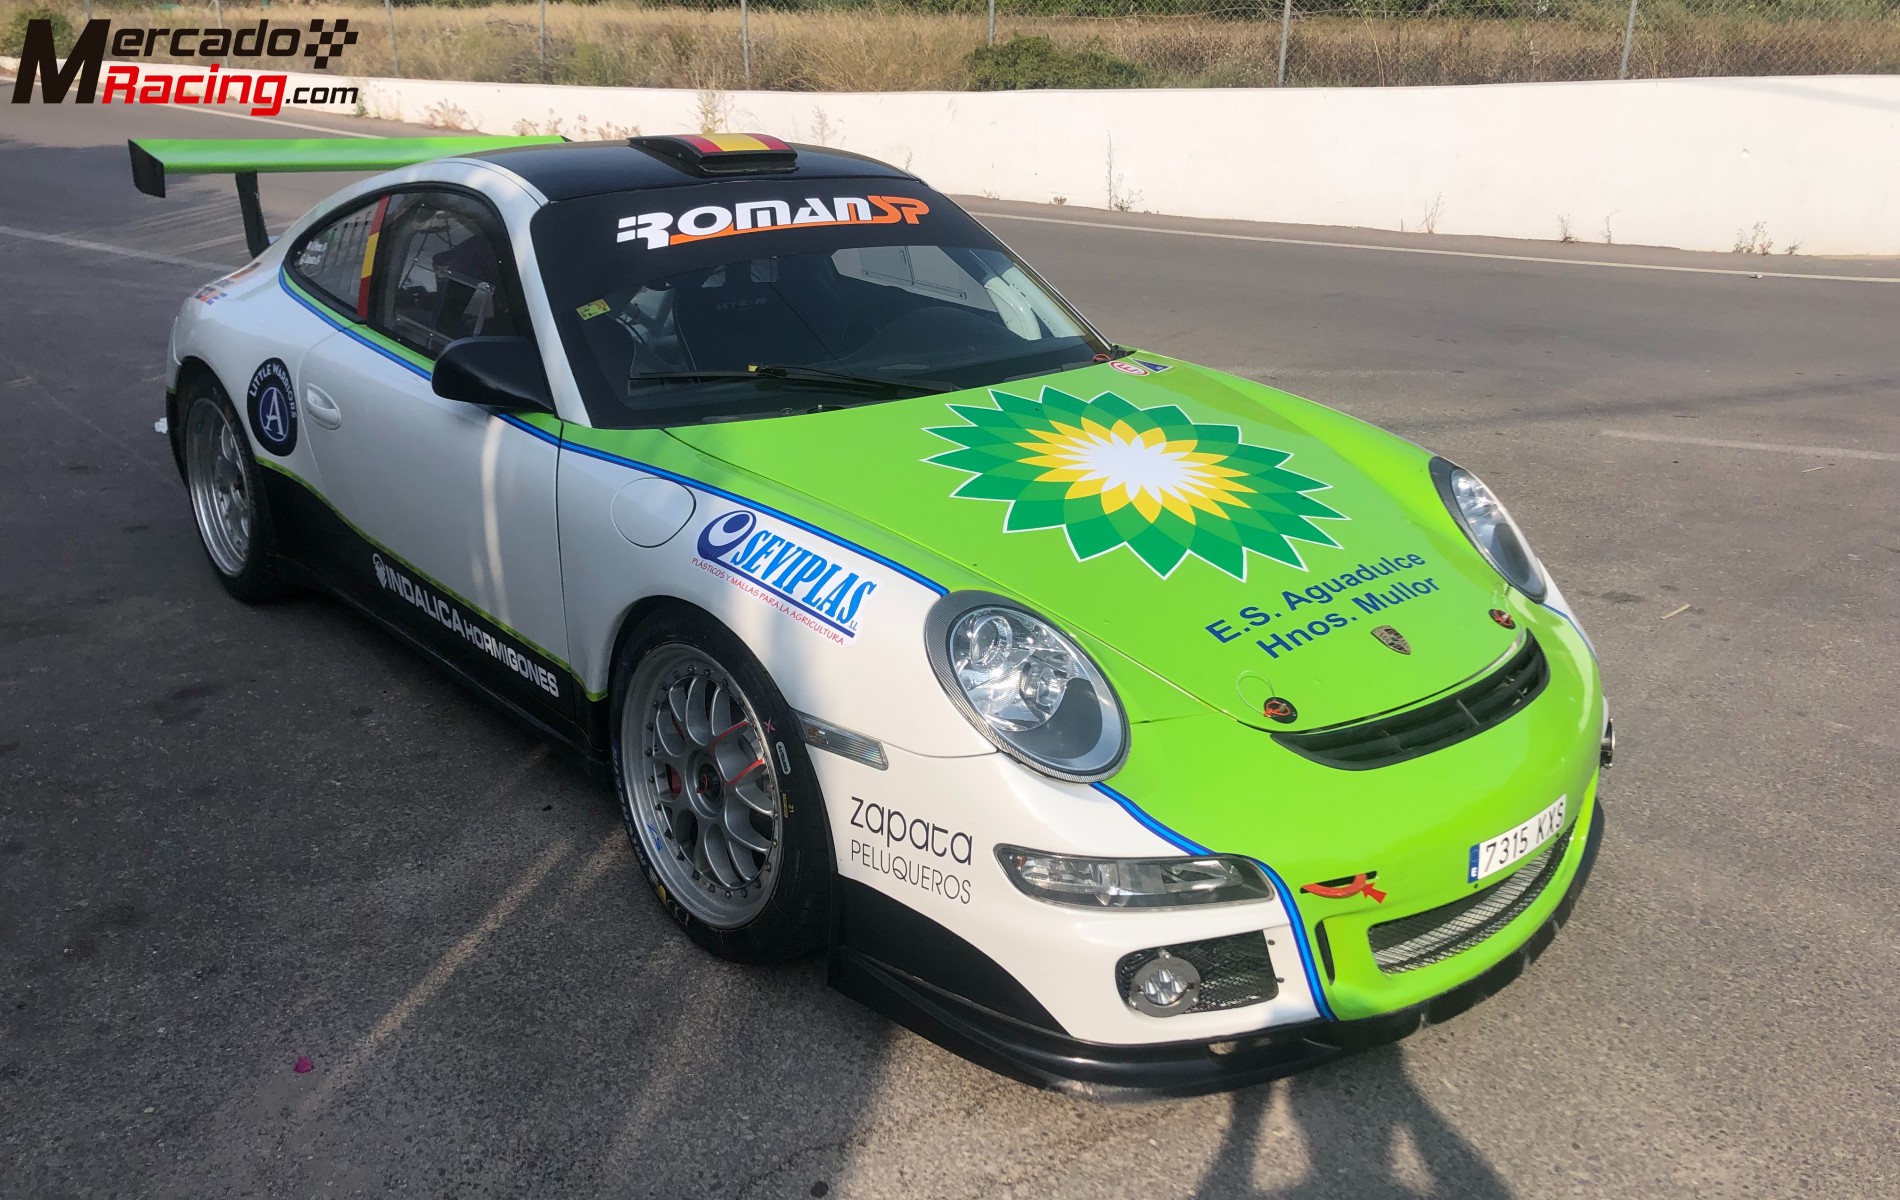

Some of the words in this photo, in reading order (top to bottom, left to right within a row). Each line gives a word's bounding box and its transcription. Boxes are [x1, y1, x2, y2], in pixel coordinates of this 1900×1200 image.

[249, 363, 272, 397] LITTLE
[272, 363, 297, 418] WARRIORS
[725, 573, 732, 582] Y
[730, 577, 760, 597] MALLAS
[759, 591, 780, 610] PARA
[780, 603, 790, 615] LA
[790, 610, 844, 645] AGRICULTURA
[730, 529, 877, 624] SEVIPLAS
[1204, 606, 1282, 644] E.S.
[1281, 553, 1426, 611] Aguadulce
[385, 564, 465, 639] INDALICA
[463, 619, 560, 698] HORMIGONES
[1255, 612, 1358, 659] Hnos.
[1350, 577, 1440, 614] Mullor
[851, 839, 972, 904] PELUQUEROS
[1484, 826, 1528, 872] 7315
